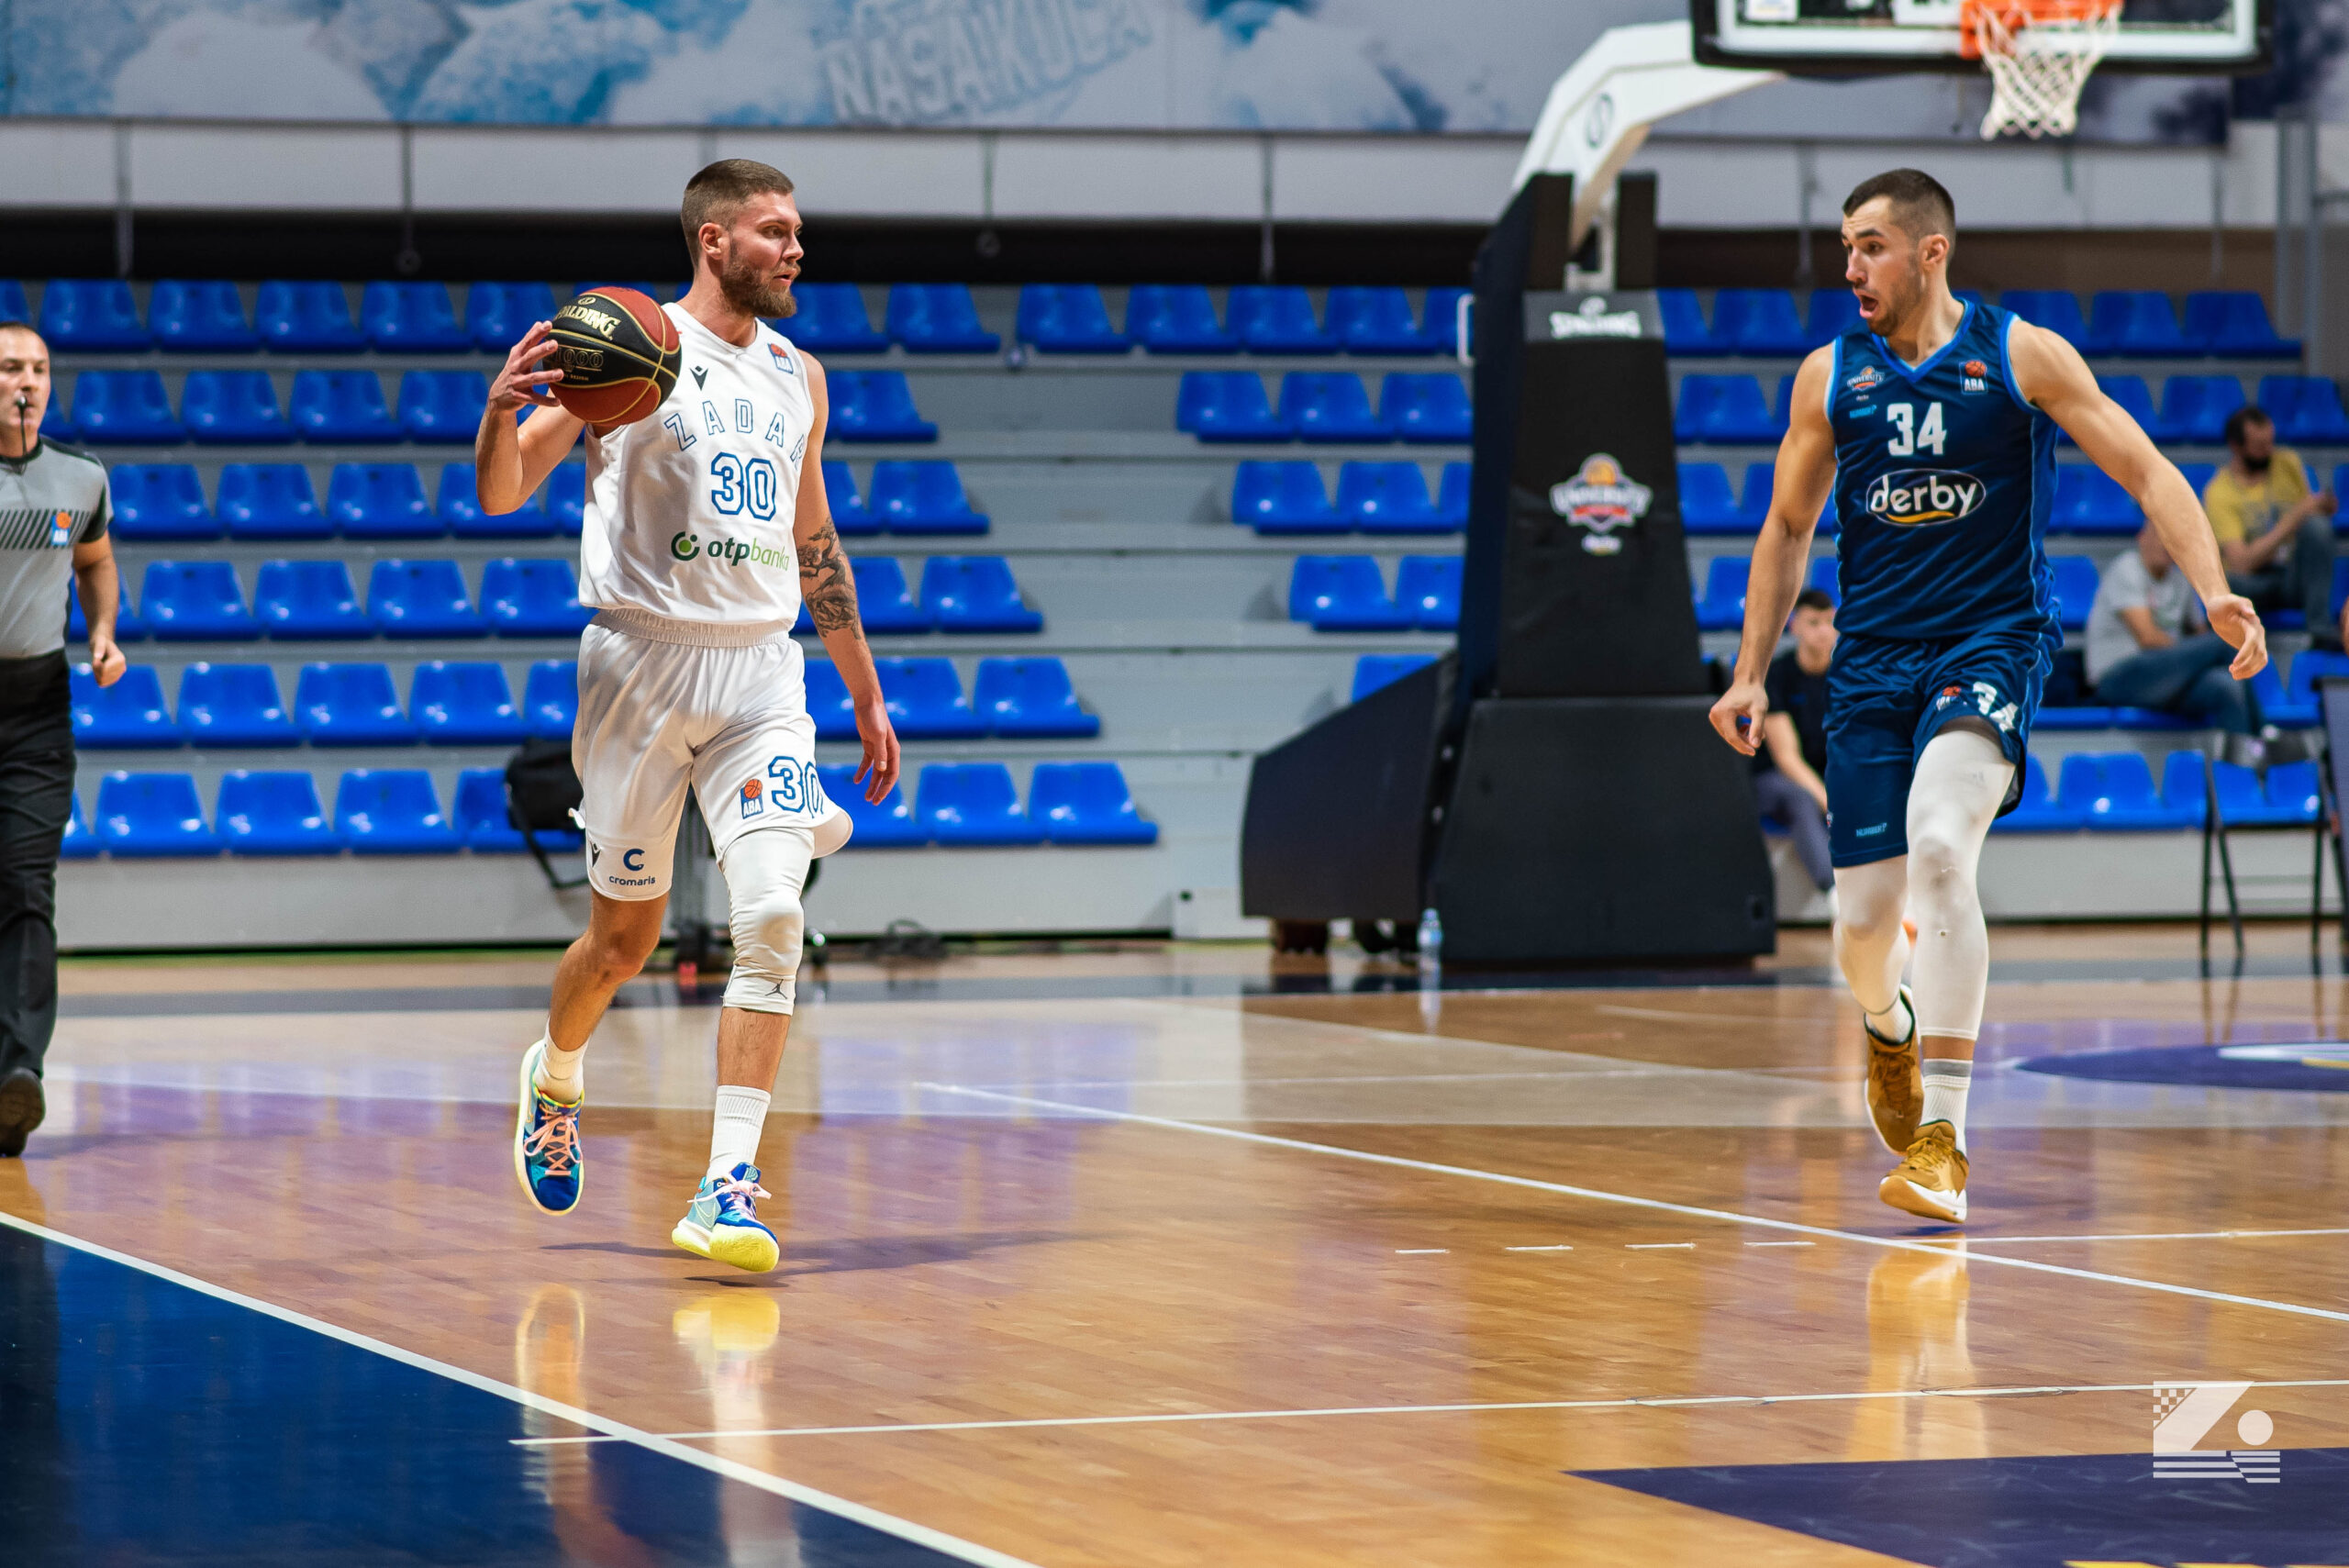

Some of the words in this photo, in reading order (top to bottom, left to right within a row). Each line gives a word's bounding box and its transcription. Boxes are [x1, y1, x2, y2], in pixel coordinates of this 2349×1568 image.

[1965, 378, 1986, 392] ABA
[1887, 402, 1947, 457] 34
[710, 451, 777, 522] 30
[1870, 474, 1977, 518] derby
[743, 798, 763, 817] ABA
[768, 755, 824, 819] 30
[608, 875, 656, 886] cromaris
